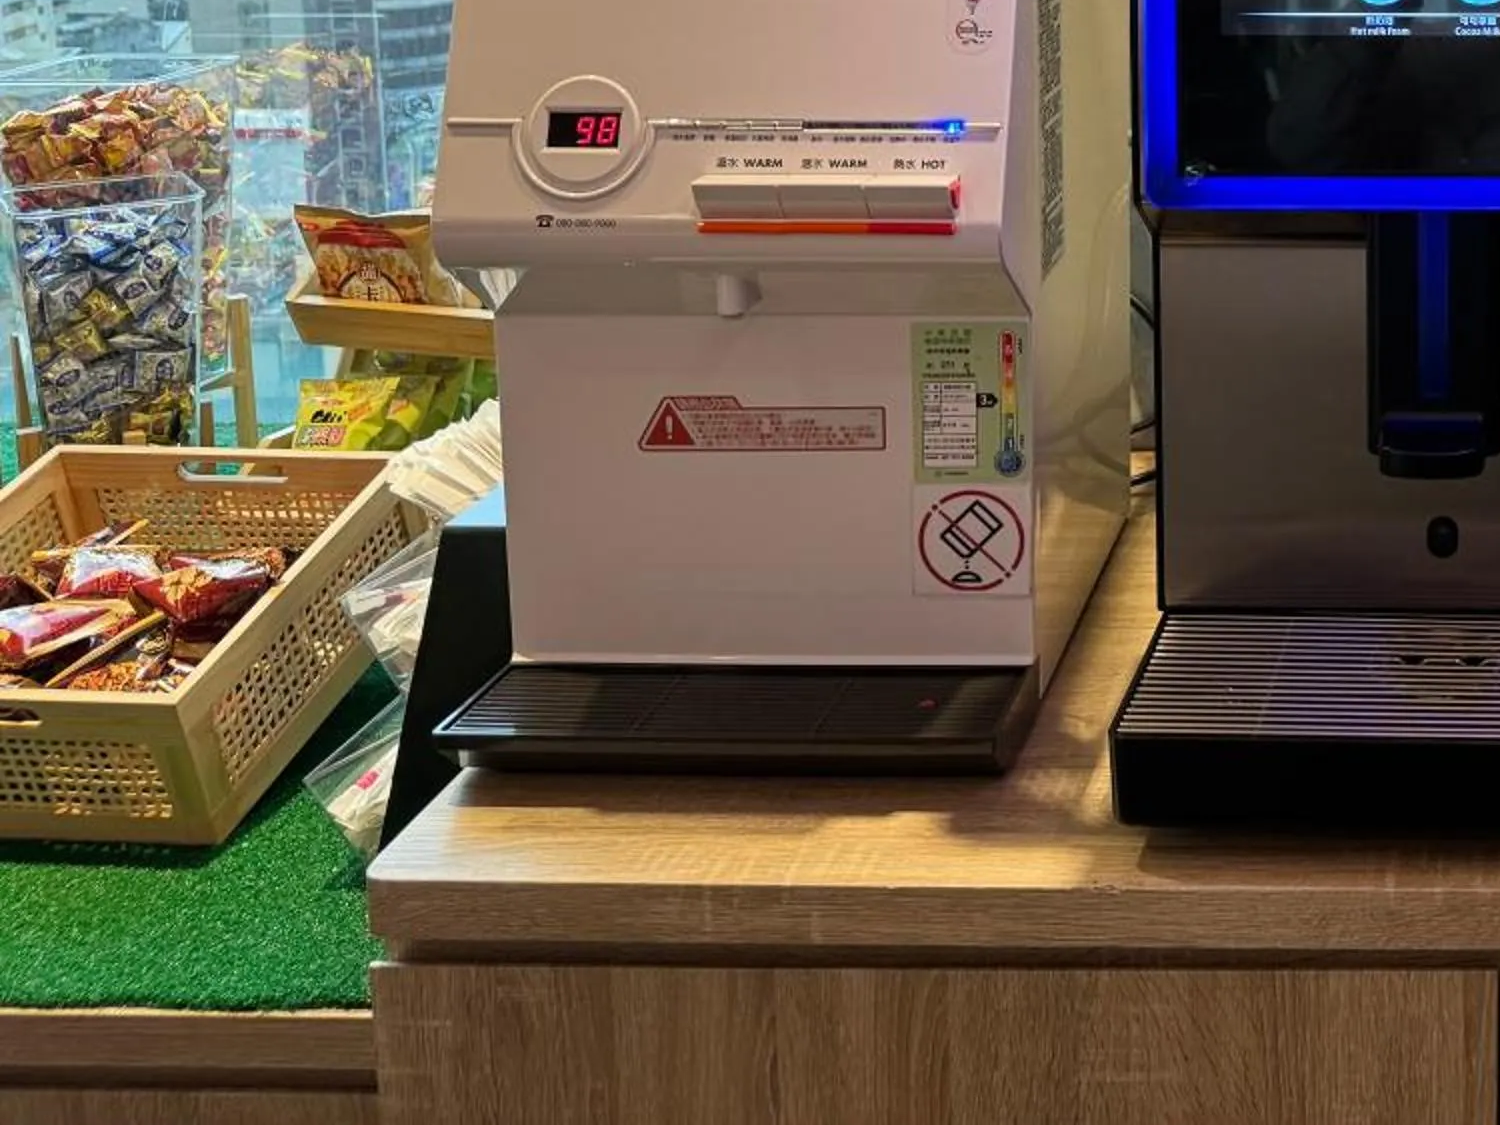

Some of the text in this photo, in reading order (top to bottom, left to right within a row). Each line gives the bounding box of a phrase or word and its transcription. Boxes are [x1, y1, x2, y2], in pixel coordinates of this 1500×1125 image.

[576, 116, 618, 144] 98
[743, 158, 783, 168] WARM
[828, 158, 867, 169] WARM
[921, 159, 946, 170] HOT
